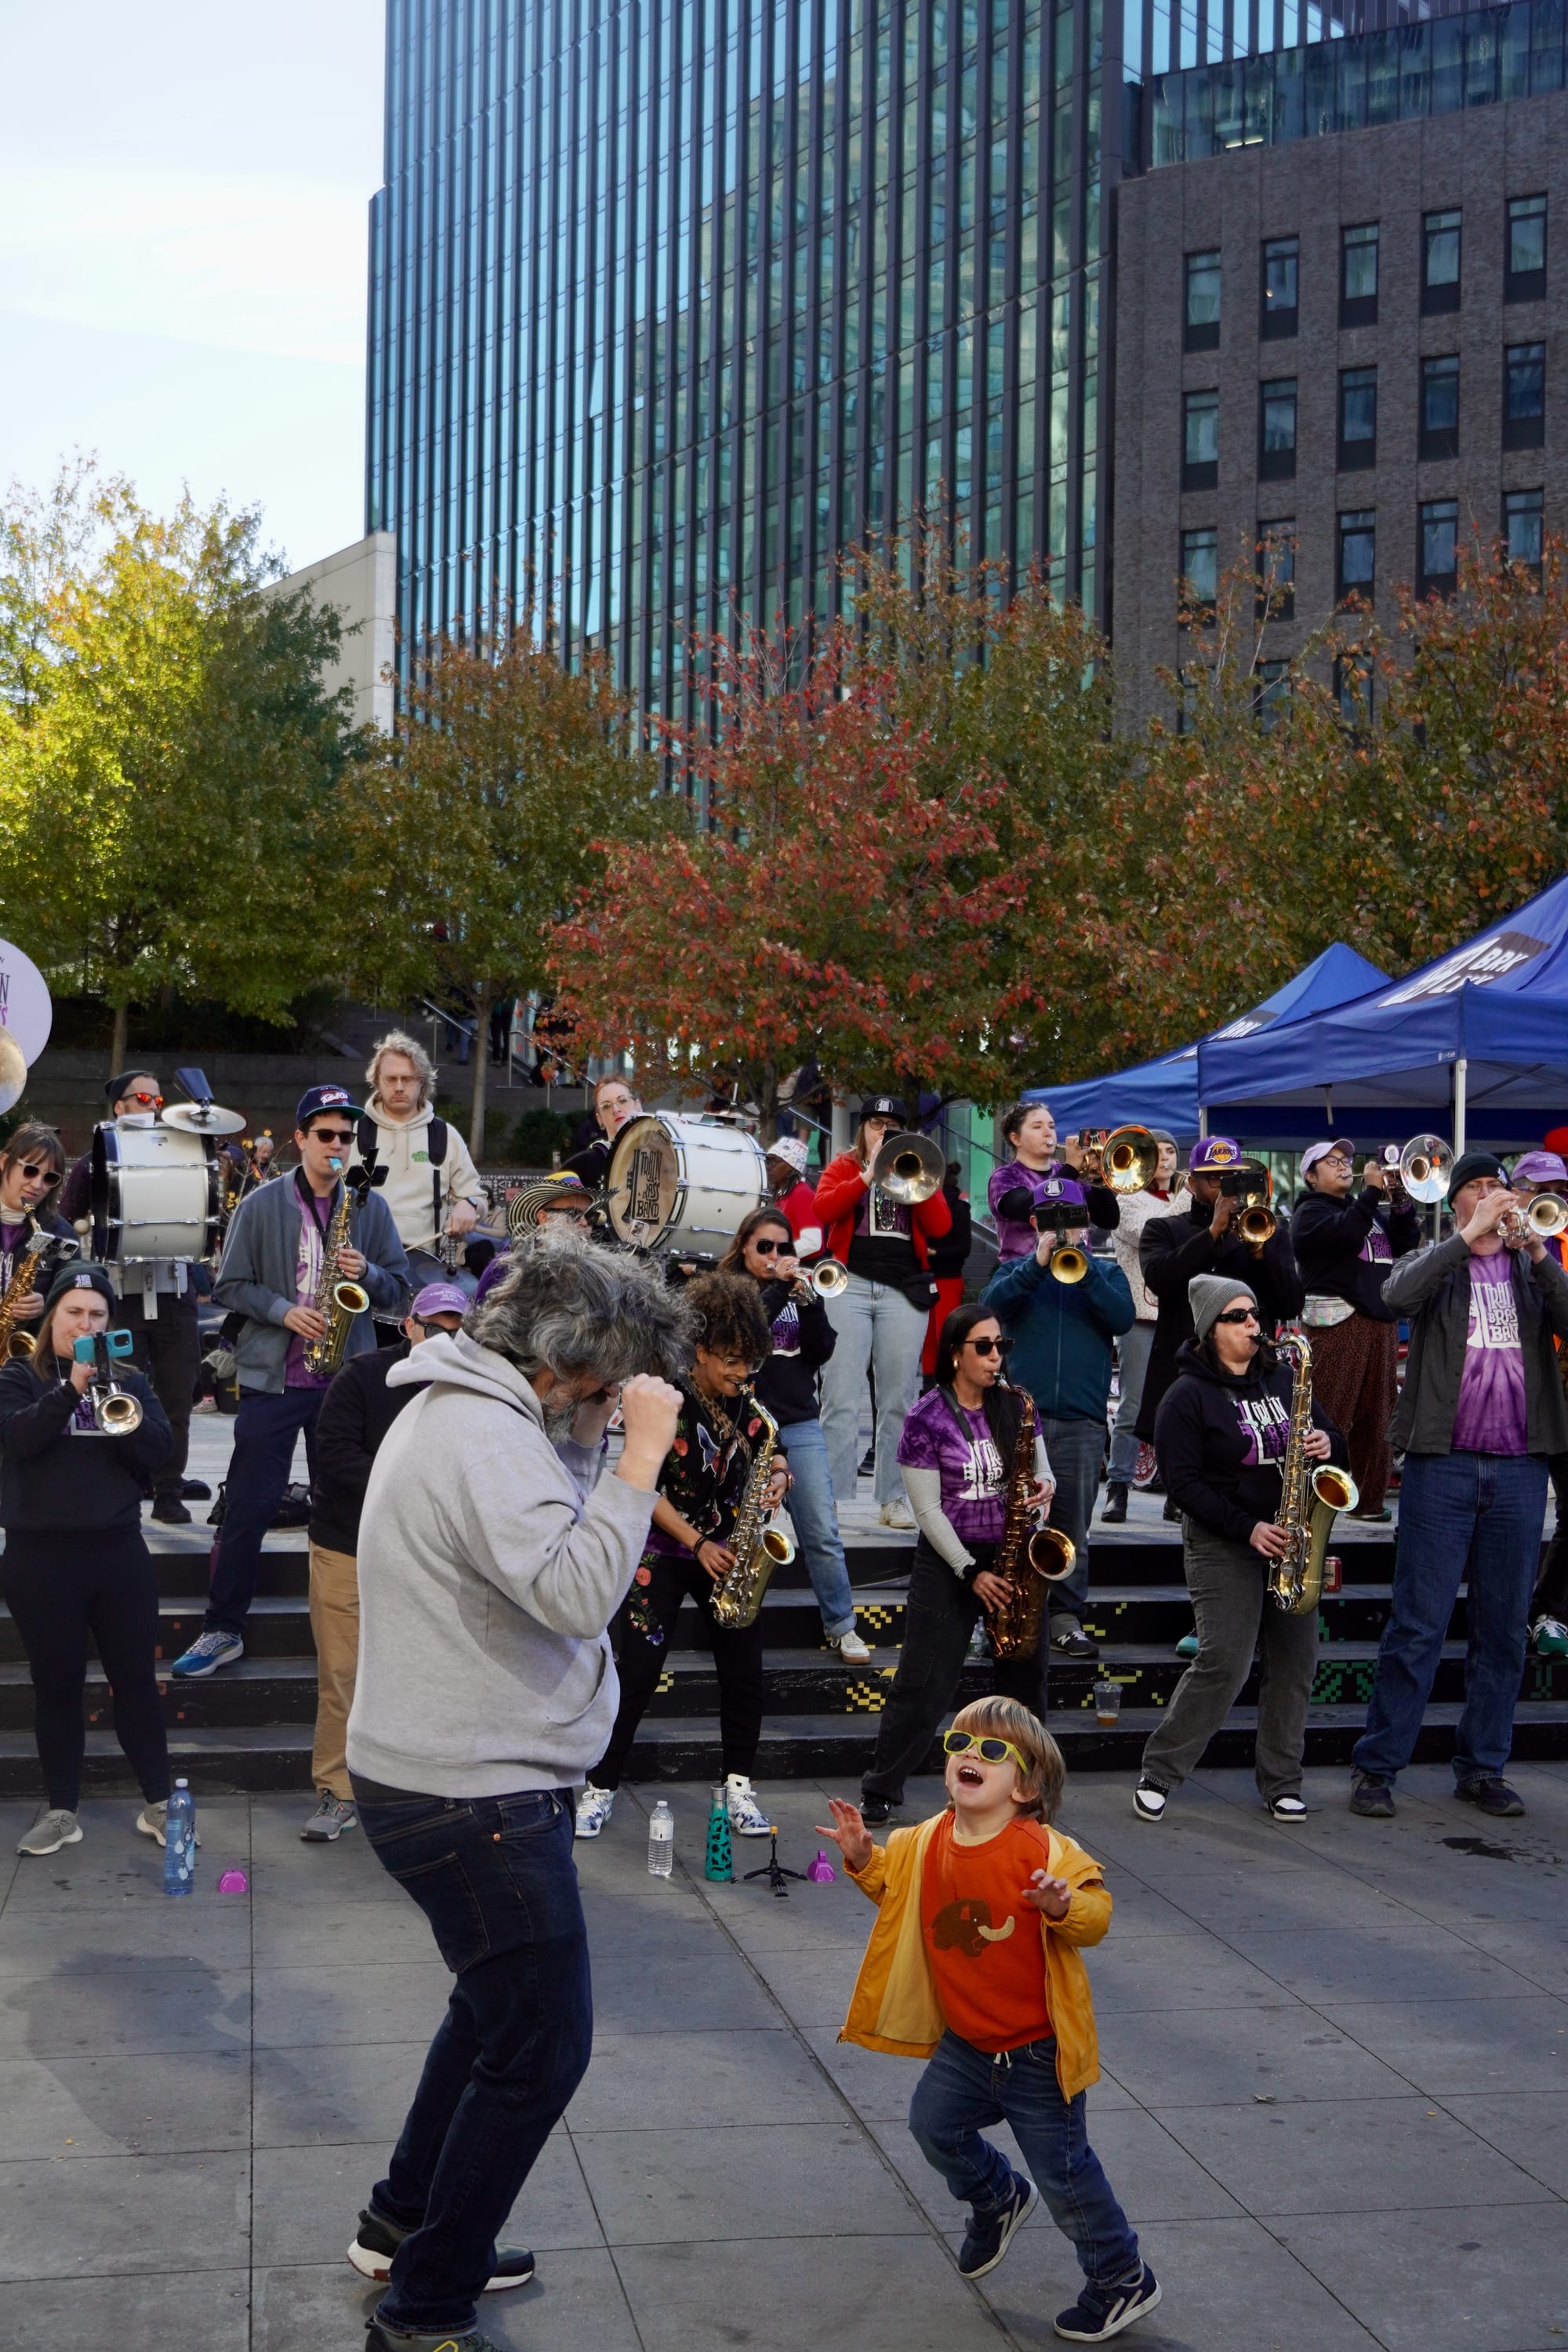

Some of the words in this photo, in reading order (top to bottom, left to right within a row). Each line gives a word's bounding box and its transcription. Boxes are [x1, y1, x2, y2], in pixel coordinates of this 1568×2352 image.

[1468, 947, 1529, 973] BRK
[1205, 1146, 1237, 1160] LAKERS
[641, 1149, 662, 1182] TRAIN
[638, 1181, 660, 1203] RASS
[637, 1199, 659, 1218] BAND
[1481, 1281, 1516, 1312] TRAI
[1490, 1323, 1519, 1342] BAN
